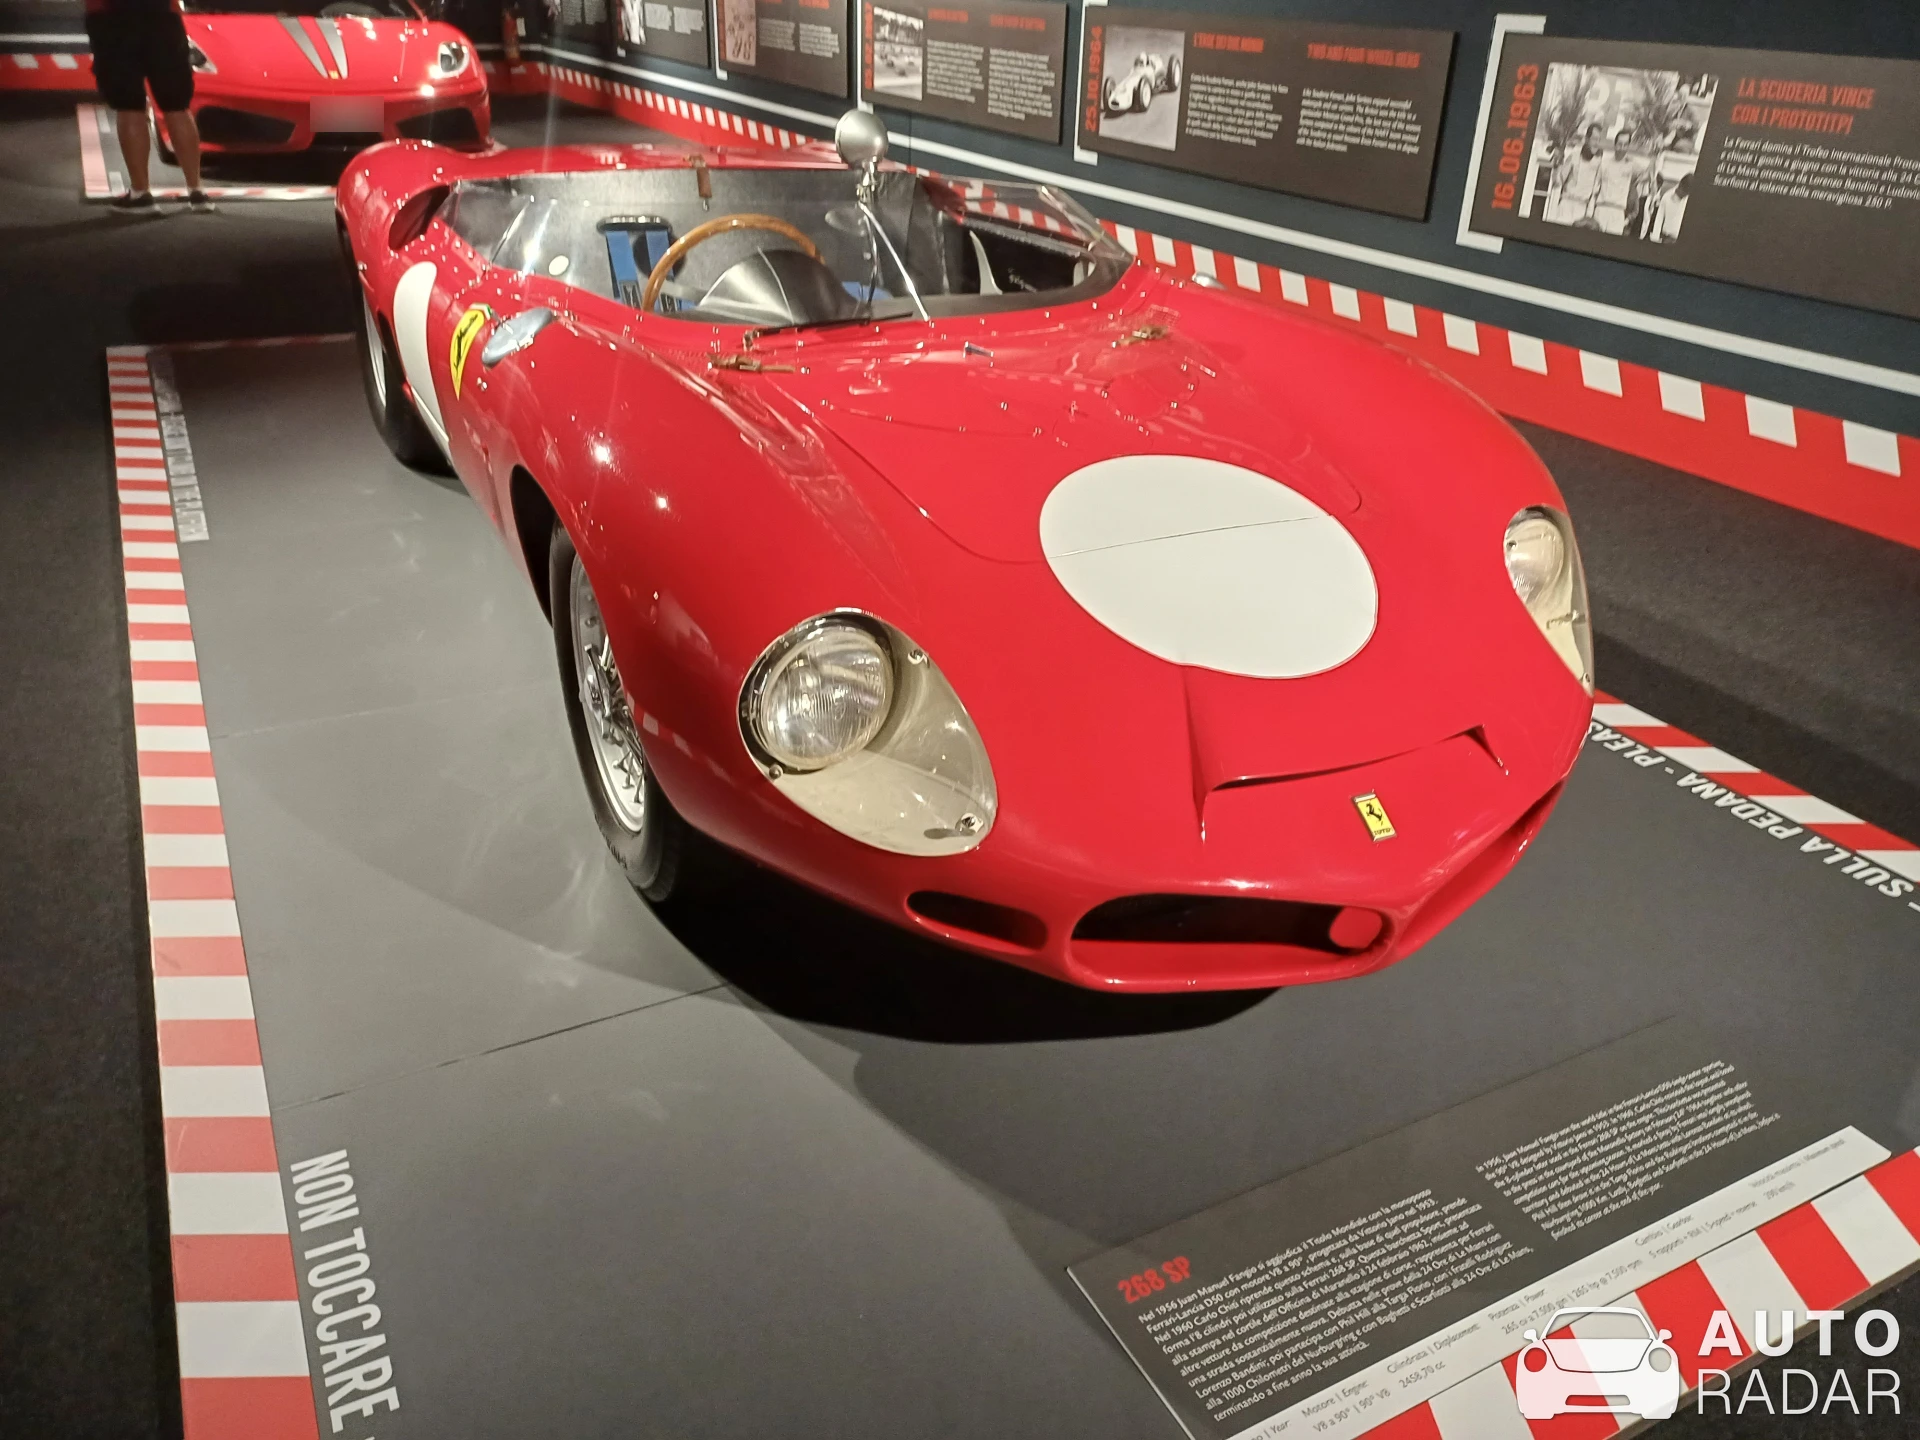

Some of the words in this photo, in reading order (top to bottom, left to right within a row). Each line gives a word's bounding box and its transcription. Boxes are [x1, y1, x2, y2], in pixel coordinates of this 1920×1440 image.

[1730, 104, 1760, 125] CON
[1761, 106, 1769, 126] I
[1737, 77, 1755, 97] LA
[1758, 79, 1828, 105] SCUDERIA
[1832, 86, 1875, 109] VINCE
[1492, 63, 1539, 210] 16.06.1963
[1676, 773, 1803, 840] PEDANA
[1799, 834, 1914, 898] SULLA
[290, 1149, 360, 1232] NON
[1117, 1268, 1166, 1303] 268
[1162, 1256, 1191, 1283] SP
[1138, 1310, 1155, 1322] Nel
[1155, 1300, 1177, 1314] 1956
[1176, 1293, 1197, 1308] Juan
[1197, 1277, 1229, 1296] Manuel
[1228, 1266, 1256, 1282] Fangio
[1257, 1261, 1265, 1270] si
[1265, 1246, 1302, 1266] aggiudica
[1302, 1241, 1308, 1249] il
[1146, 1303, 1204, 1332] Ferrari-Lancia
[1203, 1293, 1223, 1307] D50
[1224, 1287, 1240, 1298] con
[1240, 1273, 1270, 1290] motore
[1268, 1266, 1282, 1276] V8
[1308, 1239, 1348, 1262] progettata
[1154, 1330, 1171, 1344] Nel
[1171, 1320, 1193, 1335] 1960
[1193, 1311, 1217, 1325] Carlo
[1217, 1299, 1239, 1314] Chiti
[1239, 1285, 1273, 1304] riprende
[1274, 1273, 1300, 1290] questo
[1301, 1259, 1331, 1276] schema
[1162, 1338, 1190, 1354] forma
[1188, 1330, 1202, 1341] l'8
[1203, 1317, 1232, 1335] cilindri
[1232, 1311, 1247, 1324] poi
[1247, 1295, 1283, 1315] utilizzato
[1284, 1285, 1304, 1298] sulla
[1302, 1271, 1329, 1288] Ferrari
[1328, 1264, 1346, 1277] 268
[1171, 1353, 1188, 1365] alla
[1188, 1338, 1221, 1357] stampa
[1221, 1329, 1235, 1341] nel
[1235, 1318, 1262, 1334] cortile
[1262, 1296, 1311, 1322] dell'Officina
[1311, 1289, 1320, 1299] di
[1319, 1273, 1360, 1294] Maranello
[304, 1226, 400, 1434] TOCCARE
[1180, 1362, 1200, 1375] altre
[1200, 1348, 1231, 1365] vetture
[1231, 1342, 1244, 1351] da
[1244, 1316, 1298, 1345] competizione
[1298, 1298, 1334, 1319] destinate
[1334, 1291, 1350, 1302] alla
[1349, 1276, 1383, 1294] stagione
[1188, 1374, 1206, 1386] una
[1206, 1361, 1235, 1378] strada
[1235, 1329, 1300, 1364] sostanzialmente
[1300, 1317, 1329, 1332] nuova.
[1327, 1300, 1362, 1319] Debutta
[1361, 1290, 1381, 1303] nelle
[1195, 1377, 1231, 1397] Lorenzo
[1268, 1352, 1283, 1365] poi
[1284, 1333, 1323, 1357] partecipa
[1323, 1325, 1339, 1336] con
[1337, 1315, 1355, 1328] Phil
[1353, 1307, 1370, 1320] Hill
[1370, 1298, 1386, 1313] alla
[1205, 1397, 1222, 1409] alla
[1222, 1384, 1245, 1399] 1000
[1245, 1362, 1291, 1388] Chilometri
[1291, 1354, 1305, 1367] del
[1361, 1321, 1377, 1332] con
[1214, 1392, 1264, 1420] terminando
[1271, 1379, 1290, 1391] fine
[1290, 1368, 1312, 1383] anno
[1310, 1363, 1322, 1371] la
[1321, 1356, 1338, 1367] sua
[1269, 1420, 1289, 1433] Year
[1301, 1398, 1335, 1417] Motore
[1341, 1380, 1367, 1397] Engine
[1386, 1350, 1428, 1373] Cilindrata
[1312, 1420, 1327, 1431] V8
[1333, 1407, 1349, 1422] 90°
[1358, 1394, 1374, 1409] 90°
[1375, 1388, 1390, 1398] V8
[1398, 1365, 1434, 1388] 2458,70
[1434, 1361, 1445, 1369] cc
